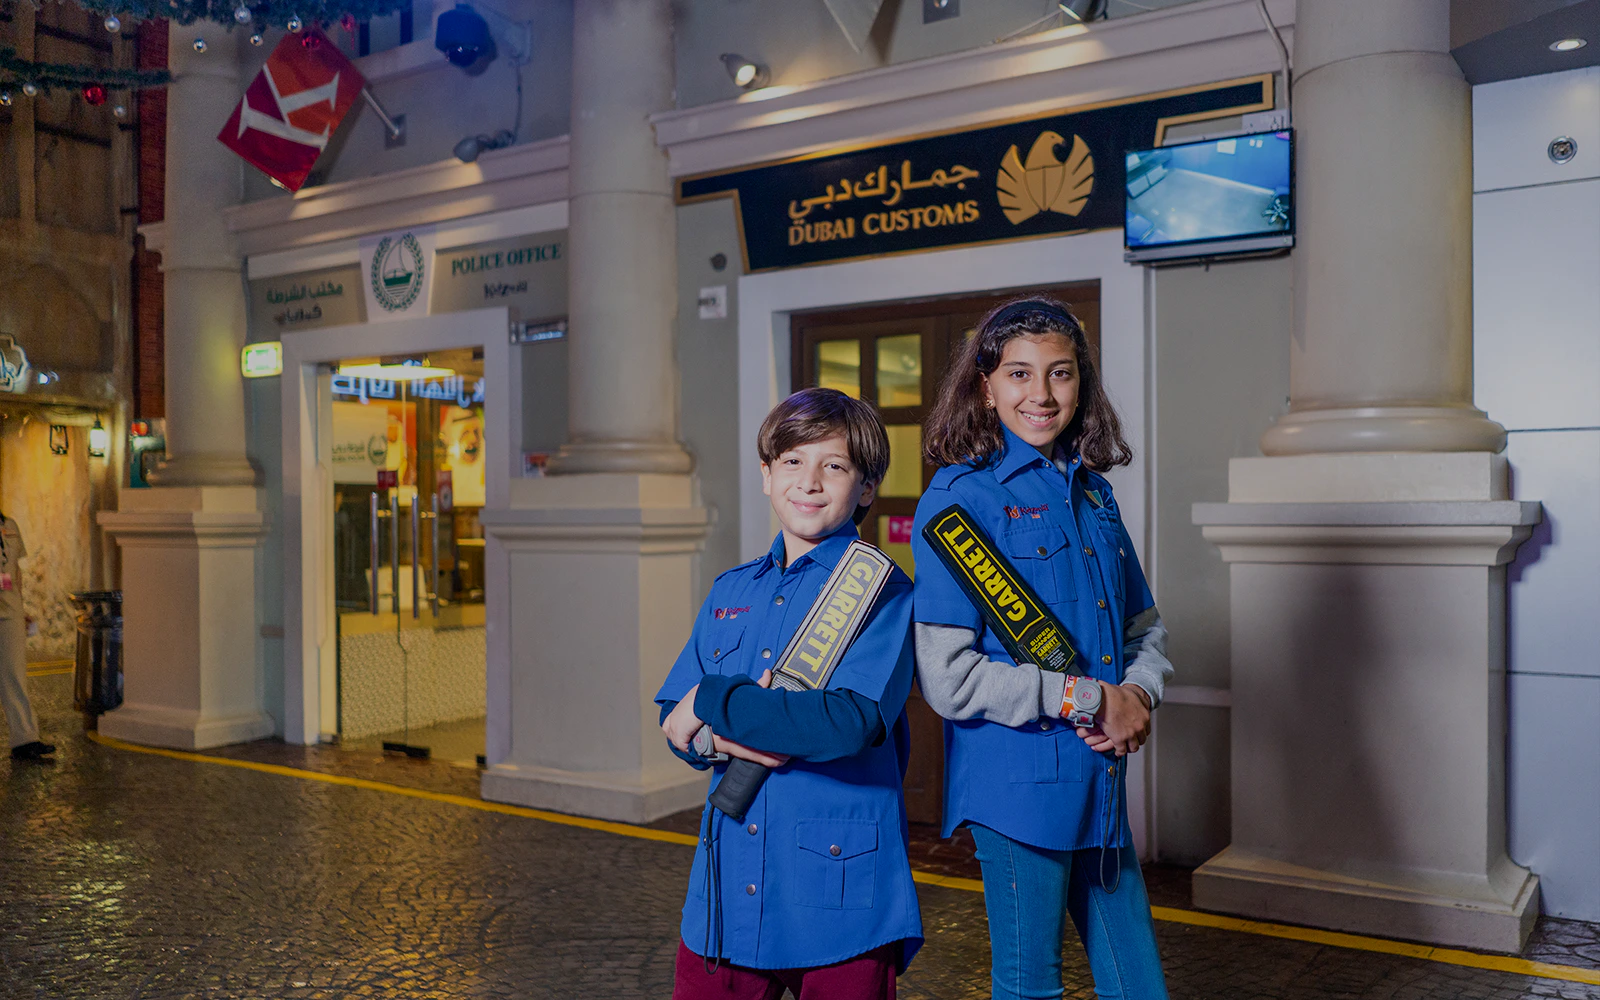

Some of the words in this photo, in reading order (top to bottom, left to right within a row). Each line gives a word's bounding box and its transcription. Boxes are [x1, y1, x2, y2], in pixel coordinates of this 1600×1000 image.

[788, 178, 852, 226] دبي
[853, 159, 980, 207] جمارك
[788, 217, 856, 247] DUBAI
[862, 200, 981, 236] CUSTOMS
[451, 250, 505, 277] POLICE
[507, 243, 563, 267] OFFICE
[942, 524, 1028, 622] GARRETT
[798, 561, 874, 673] GARRETT
[1030, 627, 1050, 646] SUPER
